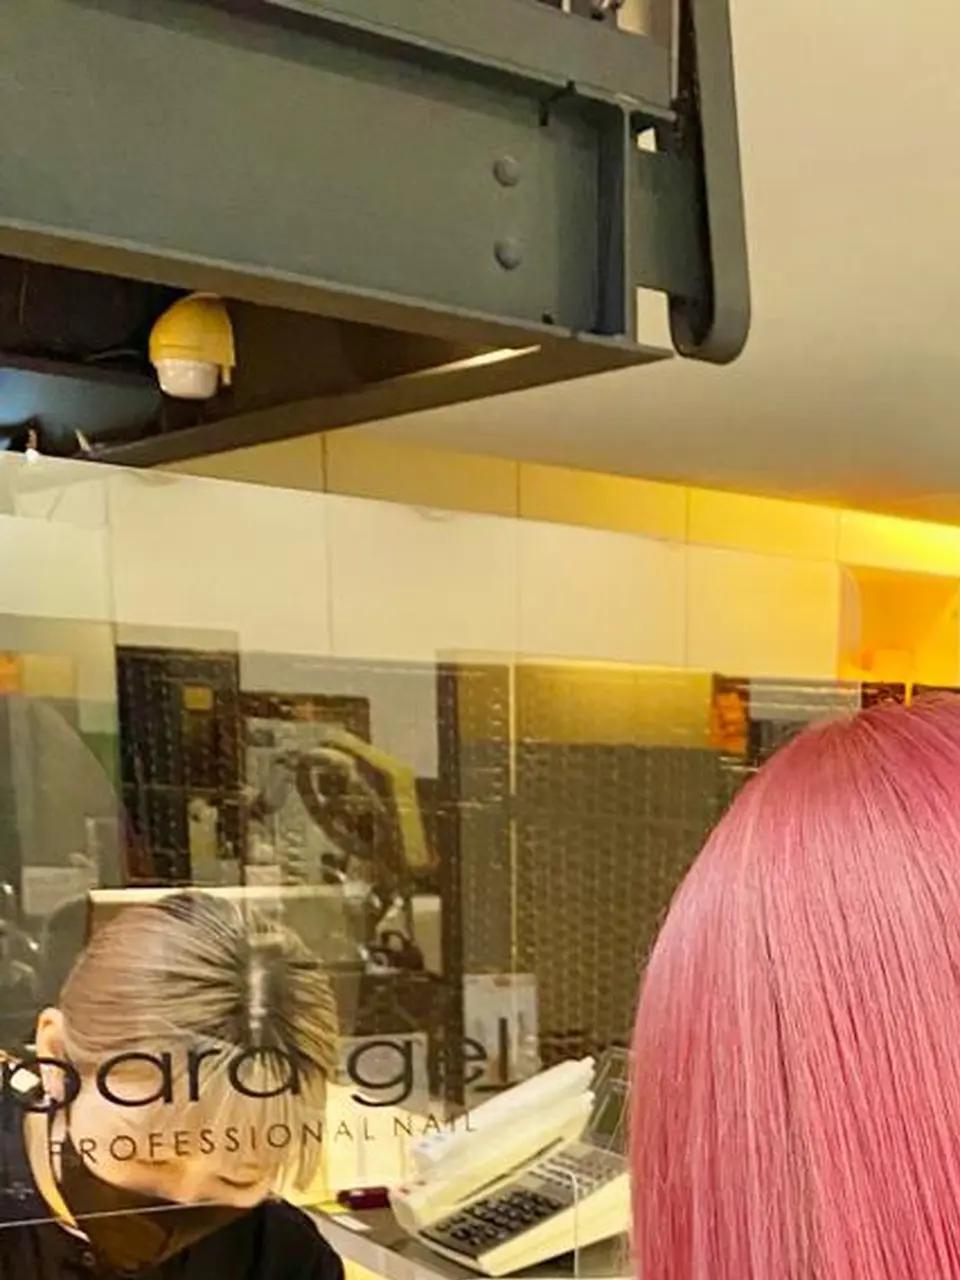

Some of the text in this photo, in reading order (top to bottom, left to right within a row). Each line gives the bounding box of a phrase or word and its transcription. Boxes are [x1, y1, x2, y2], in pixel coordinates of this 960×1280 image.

[1, 1017, 508, 1125] para gel
[49, 1113, 477, 1167] PROFESSIONAL NAIL
